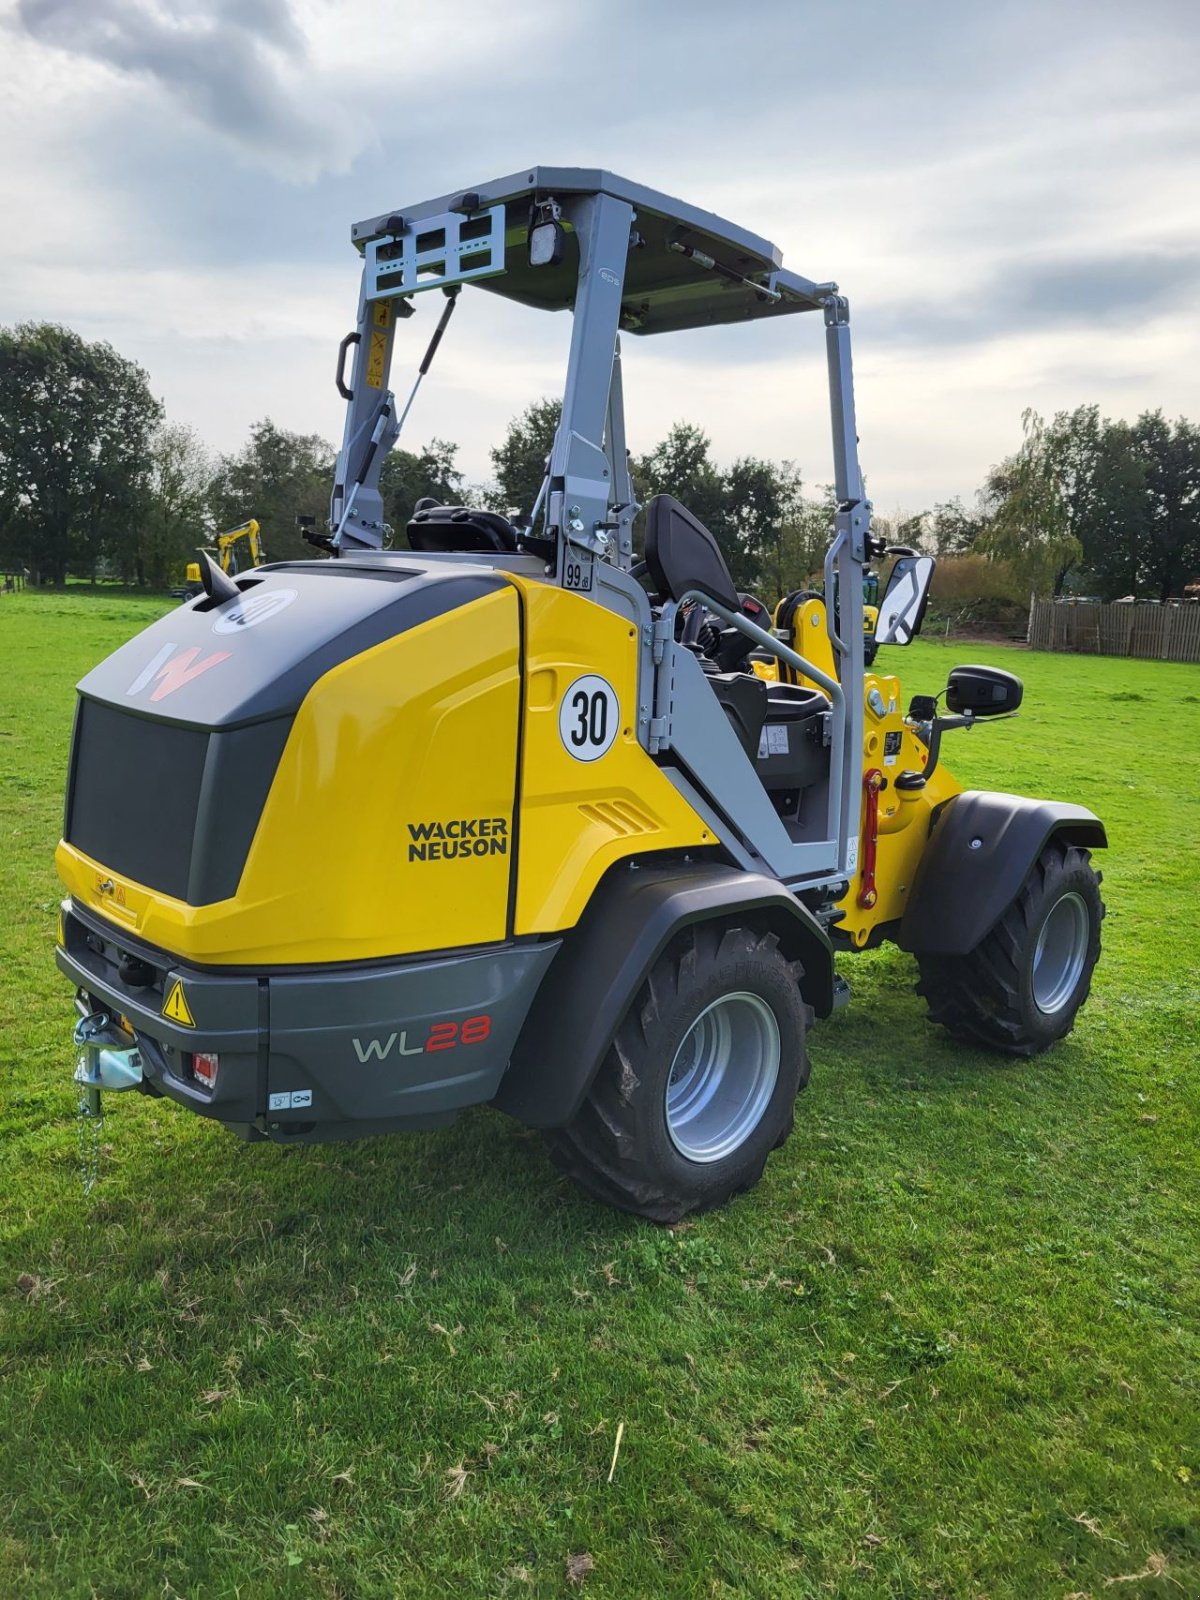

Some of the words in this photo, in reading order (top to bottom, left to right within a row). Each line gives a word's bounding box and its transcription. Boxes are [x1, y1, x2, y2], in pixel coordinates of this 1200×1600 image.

[566, 563, 581, 587] 99
[571, 690, 608, 747] 30
[407, 818, 508, 842] WACKER
[408, 837, 507, 862] NEUSON
[352, 1015, 492, 1063] WL28
